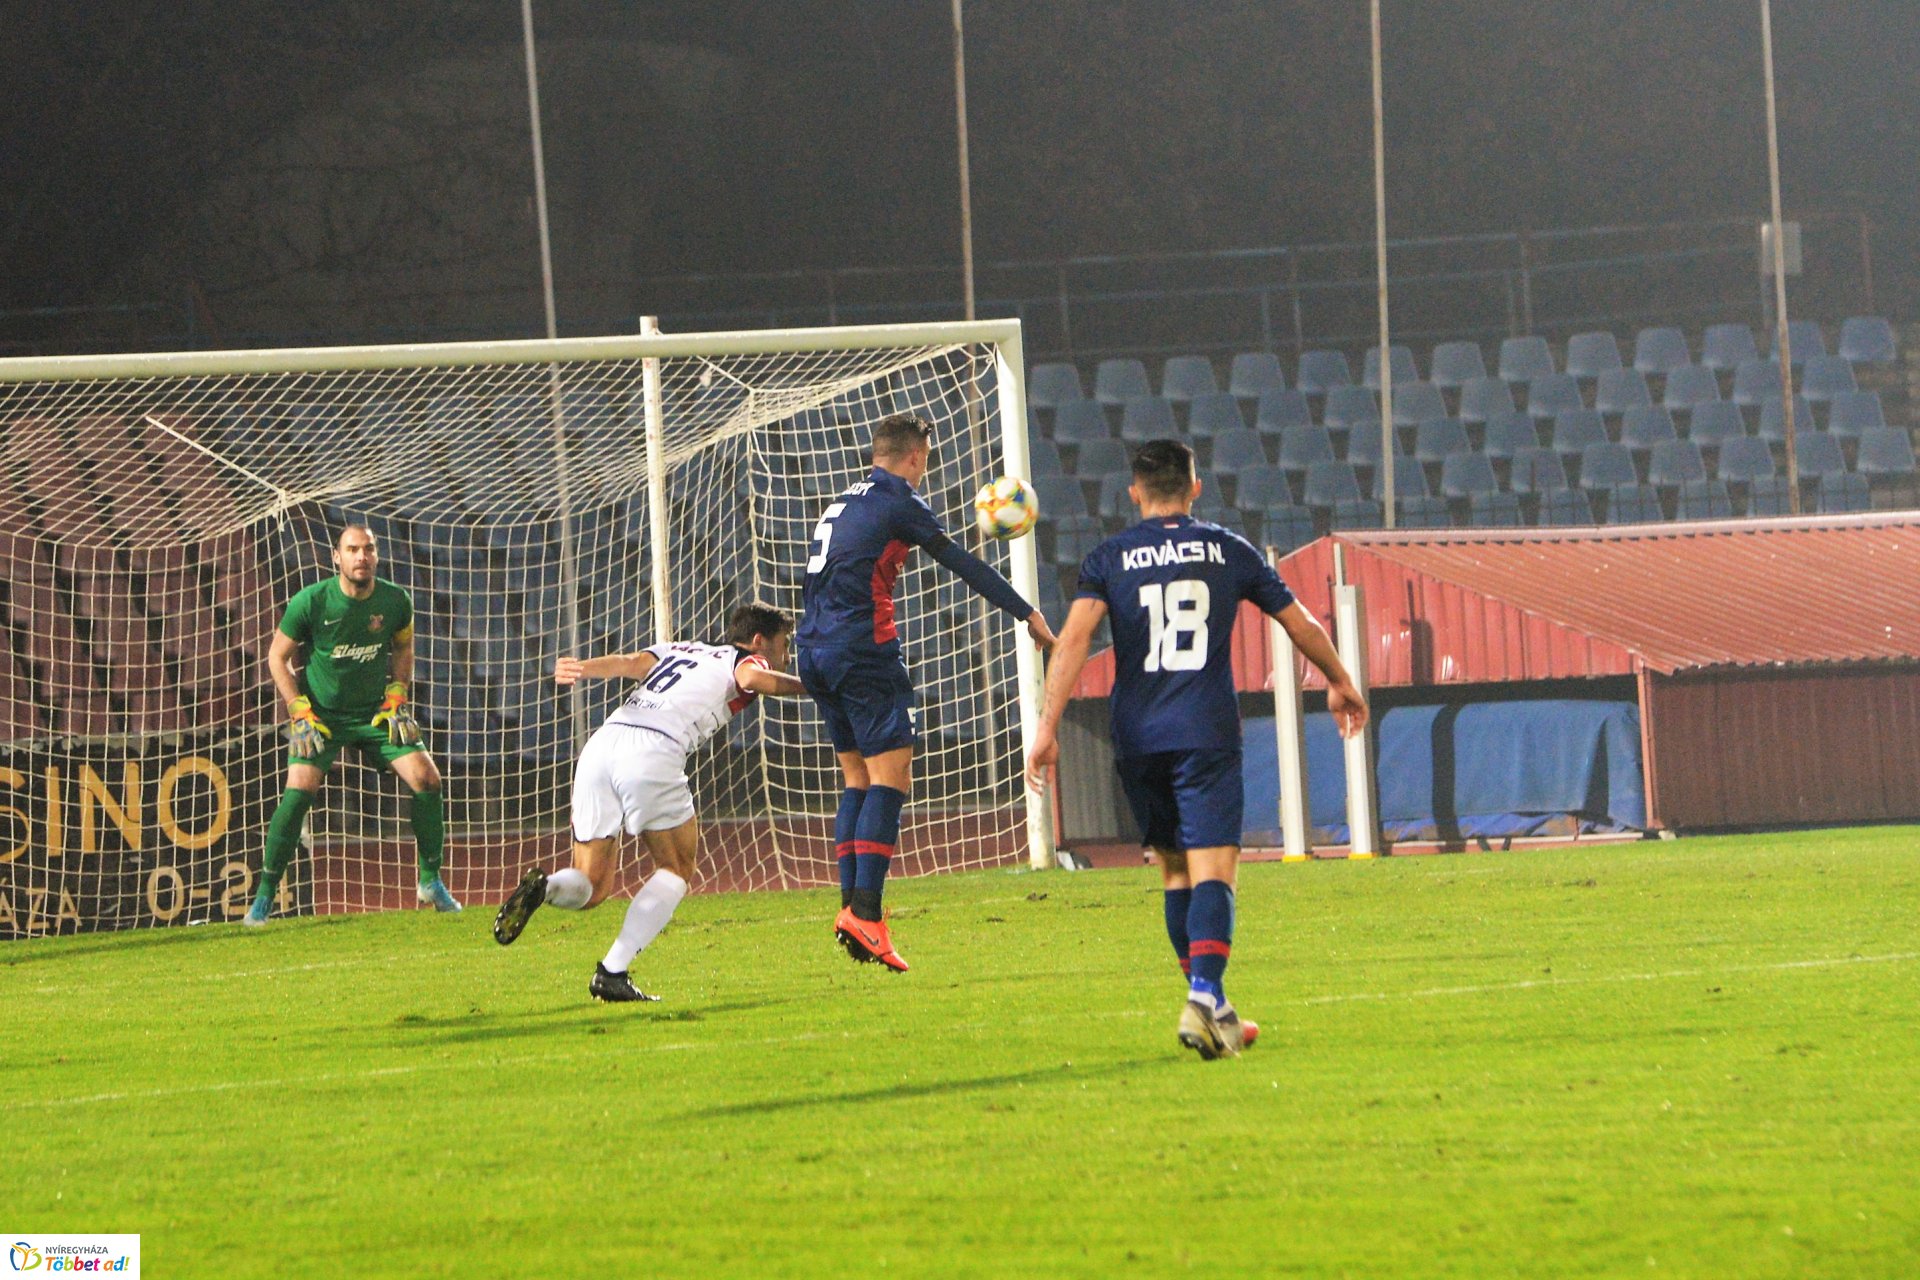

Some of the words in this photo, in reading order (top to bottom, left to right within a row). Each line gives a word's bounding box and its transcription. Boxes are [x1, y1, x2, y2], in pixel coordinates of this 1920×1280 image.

[806, 503, 847, 574] 5
[1122, 539, 1206, 571] KOVÁCS
[1207, 541, 1226, 565] N.
[1139, 579, 1210, 673] 18
[638, 655, 699, 694] 16
